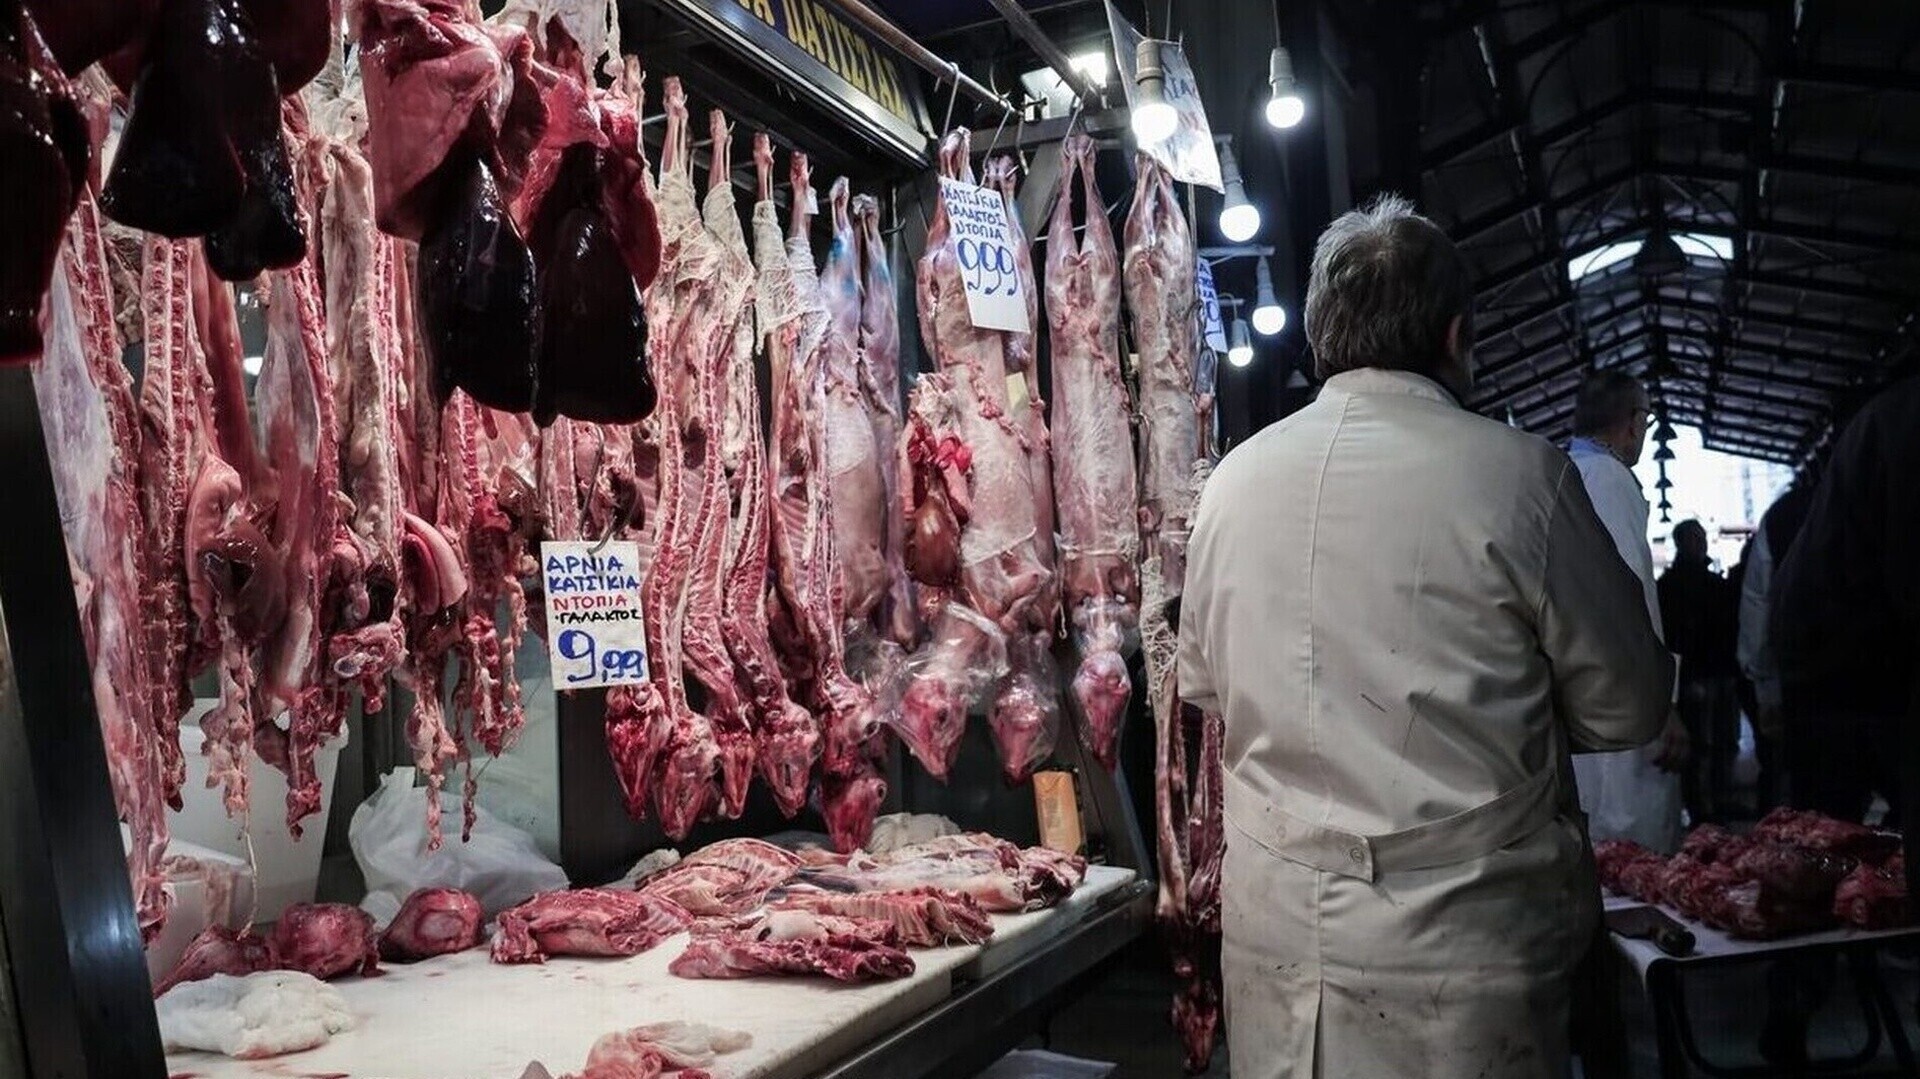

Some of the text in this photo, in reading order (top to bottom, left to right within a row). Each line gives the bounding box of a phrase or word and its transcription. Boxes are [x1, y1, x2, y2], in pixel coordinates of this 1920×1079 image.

[957, 237, 1018, 296] 999
[546, 554, 624, 574] ΑΡΝΙΑ
[548, 575, 640, 594] ΚΑΤΣΙΚΙΑ
[552, 593, 628, 612] ΝΤΟΠΙΑ
[558, 629, 645, 683] 9,99
